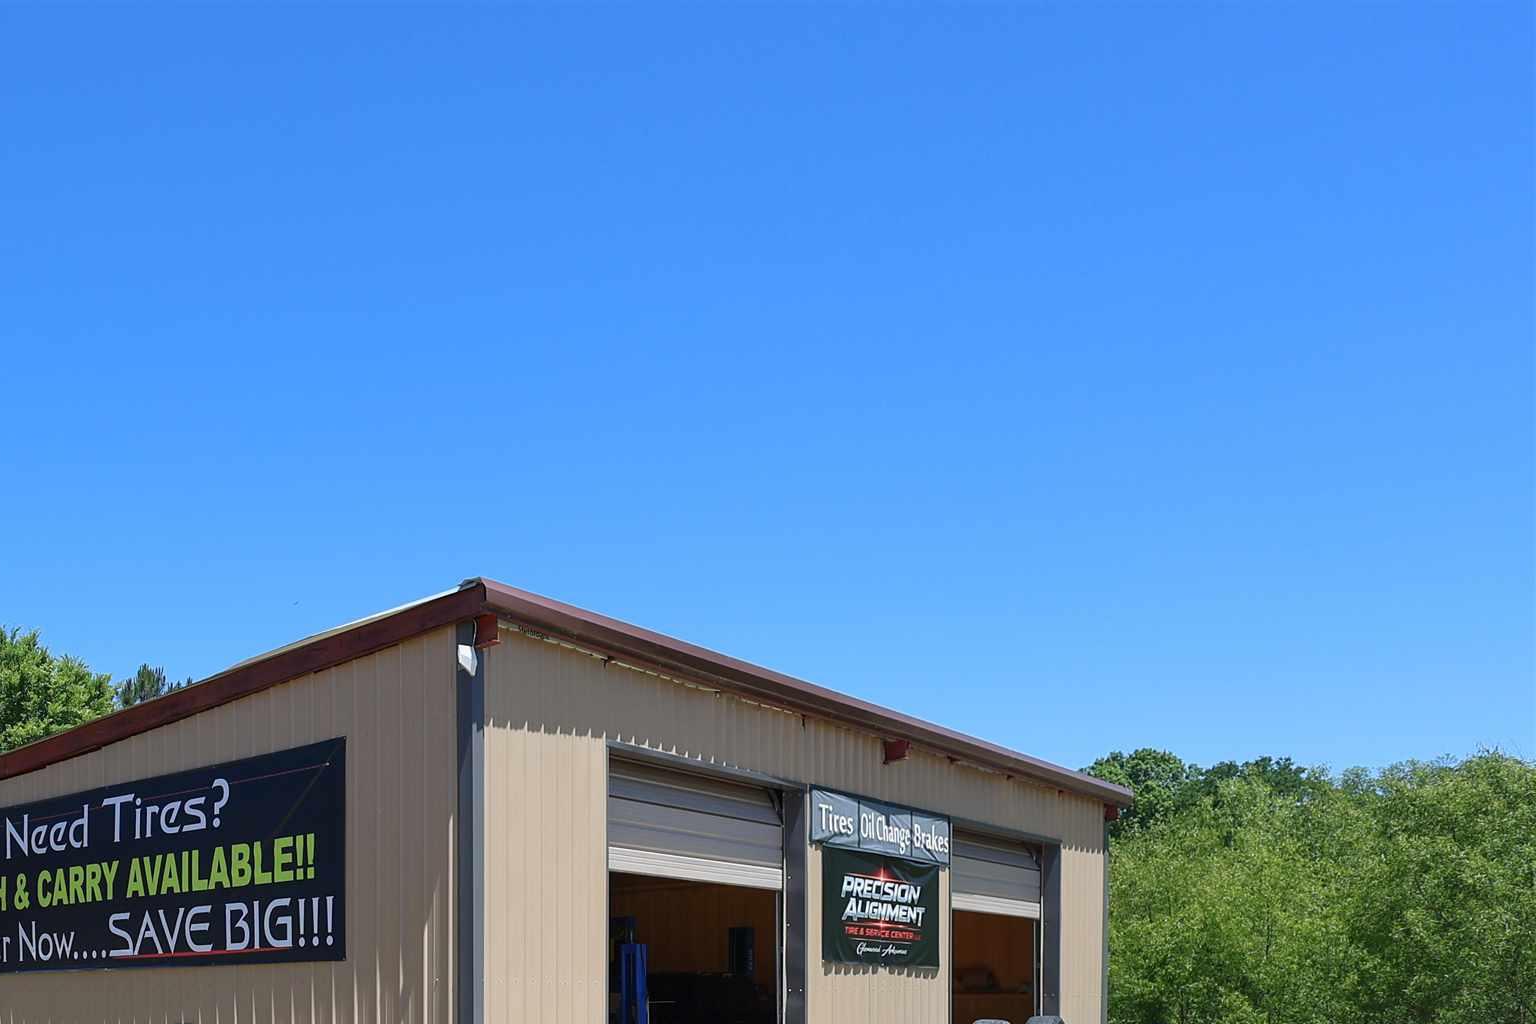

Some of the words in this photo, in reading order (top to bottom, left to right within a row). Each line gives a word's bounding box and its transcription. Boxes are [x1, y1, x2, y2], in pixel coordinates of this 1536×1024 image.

[6, 804, 89, 859] Need
[102, 778, 230, 842] Tires?
[818, 803, 854, 834] Tires
[860, 813, 875, 840] Oil
[876, 815, 911, 854] Change
[913, 823, 949, 853] Brakes
[14, 873, 30, 910] &
[37, 860, 120, 908] CARRY
[126, 833, 315, 898] AVAILABLE!!
[841, 875, 921, 905] PRECISION
[225, 896, 334, 951] BIG!!!
[841, 897, 926, 927] ALIGNMENT
[890, 930, 913, 940] CENTER
